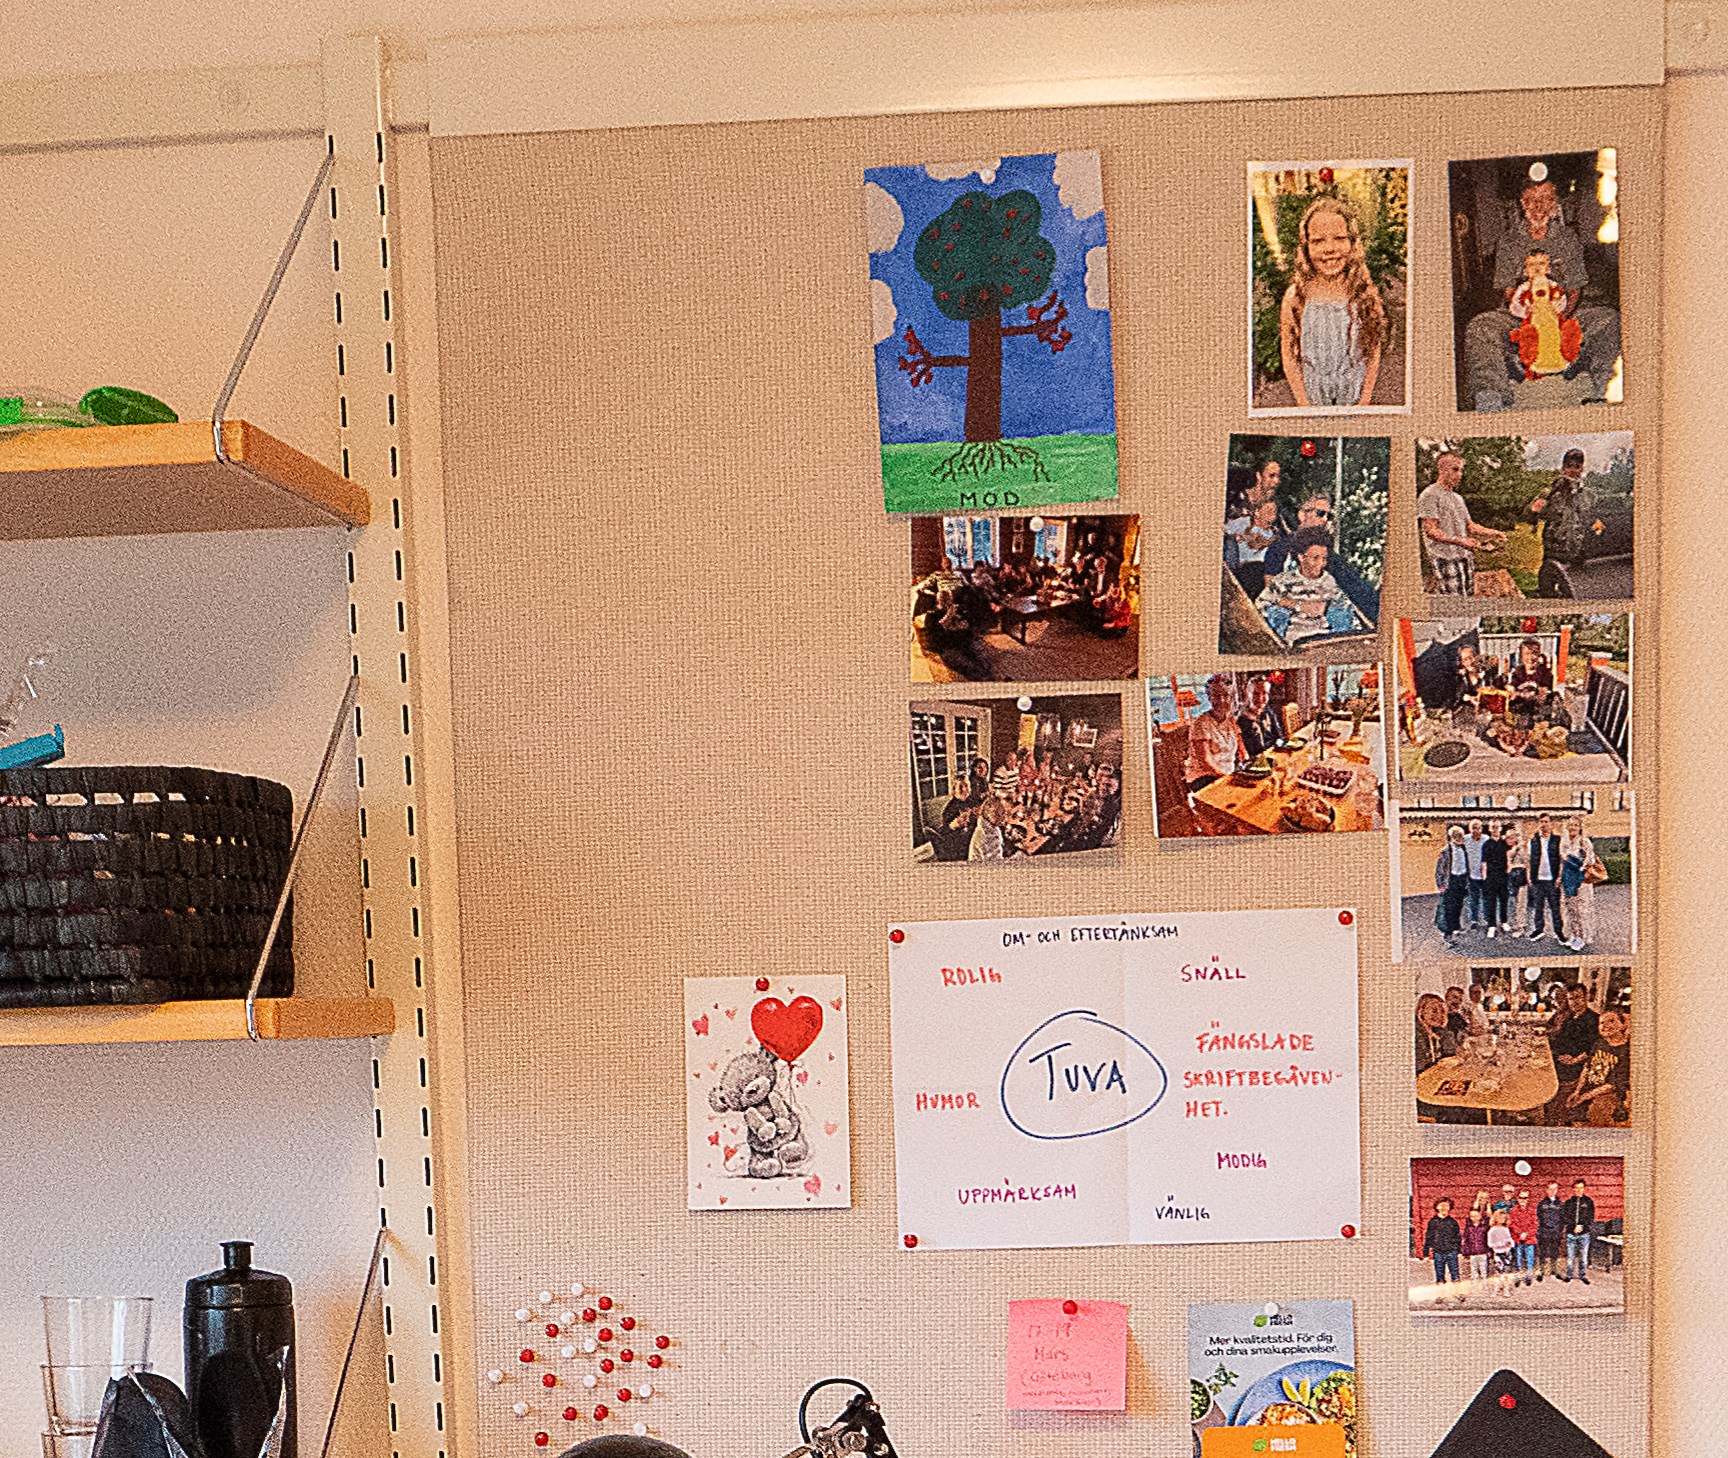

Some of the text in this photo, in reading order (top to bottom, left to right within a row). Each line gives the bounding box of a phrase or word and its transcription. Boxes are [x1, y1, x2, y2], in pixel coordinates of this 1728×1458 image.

[960, 491, 1020, 507] MOD
[1038, 929, 1061, 944] OCH
[1071, 921, 1179, 942] EFTERTÄNKSAM
[941, 966, 1003, 988] ROLIG
[1180, 955, 1247, 983] SNÄLL
[1196, 1021, 1315, 1054] FÄNGSLADE
[1029, 1042, 1127, 1101] TUVA
[916, 1092, 980, 1112] HUMOR
[1185, 1100, 1229, 1119] HET.
[1217, 1152, 1267, 1170] MODIG
[1155, 1195, 1210, 1221] VÄNLIG
[1316, 1331, 1333, 1344] dig
[1204, 1346, 1224, 1357] och
[1226, 1346, 1248, 1356] dina
